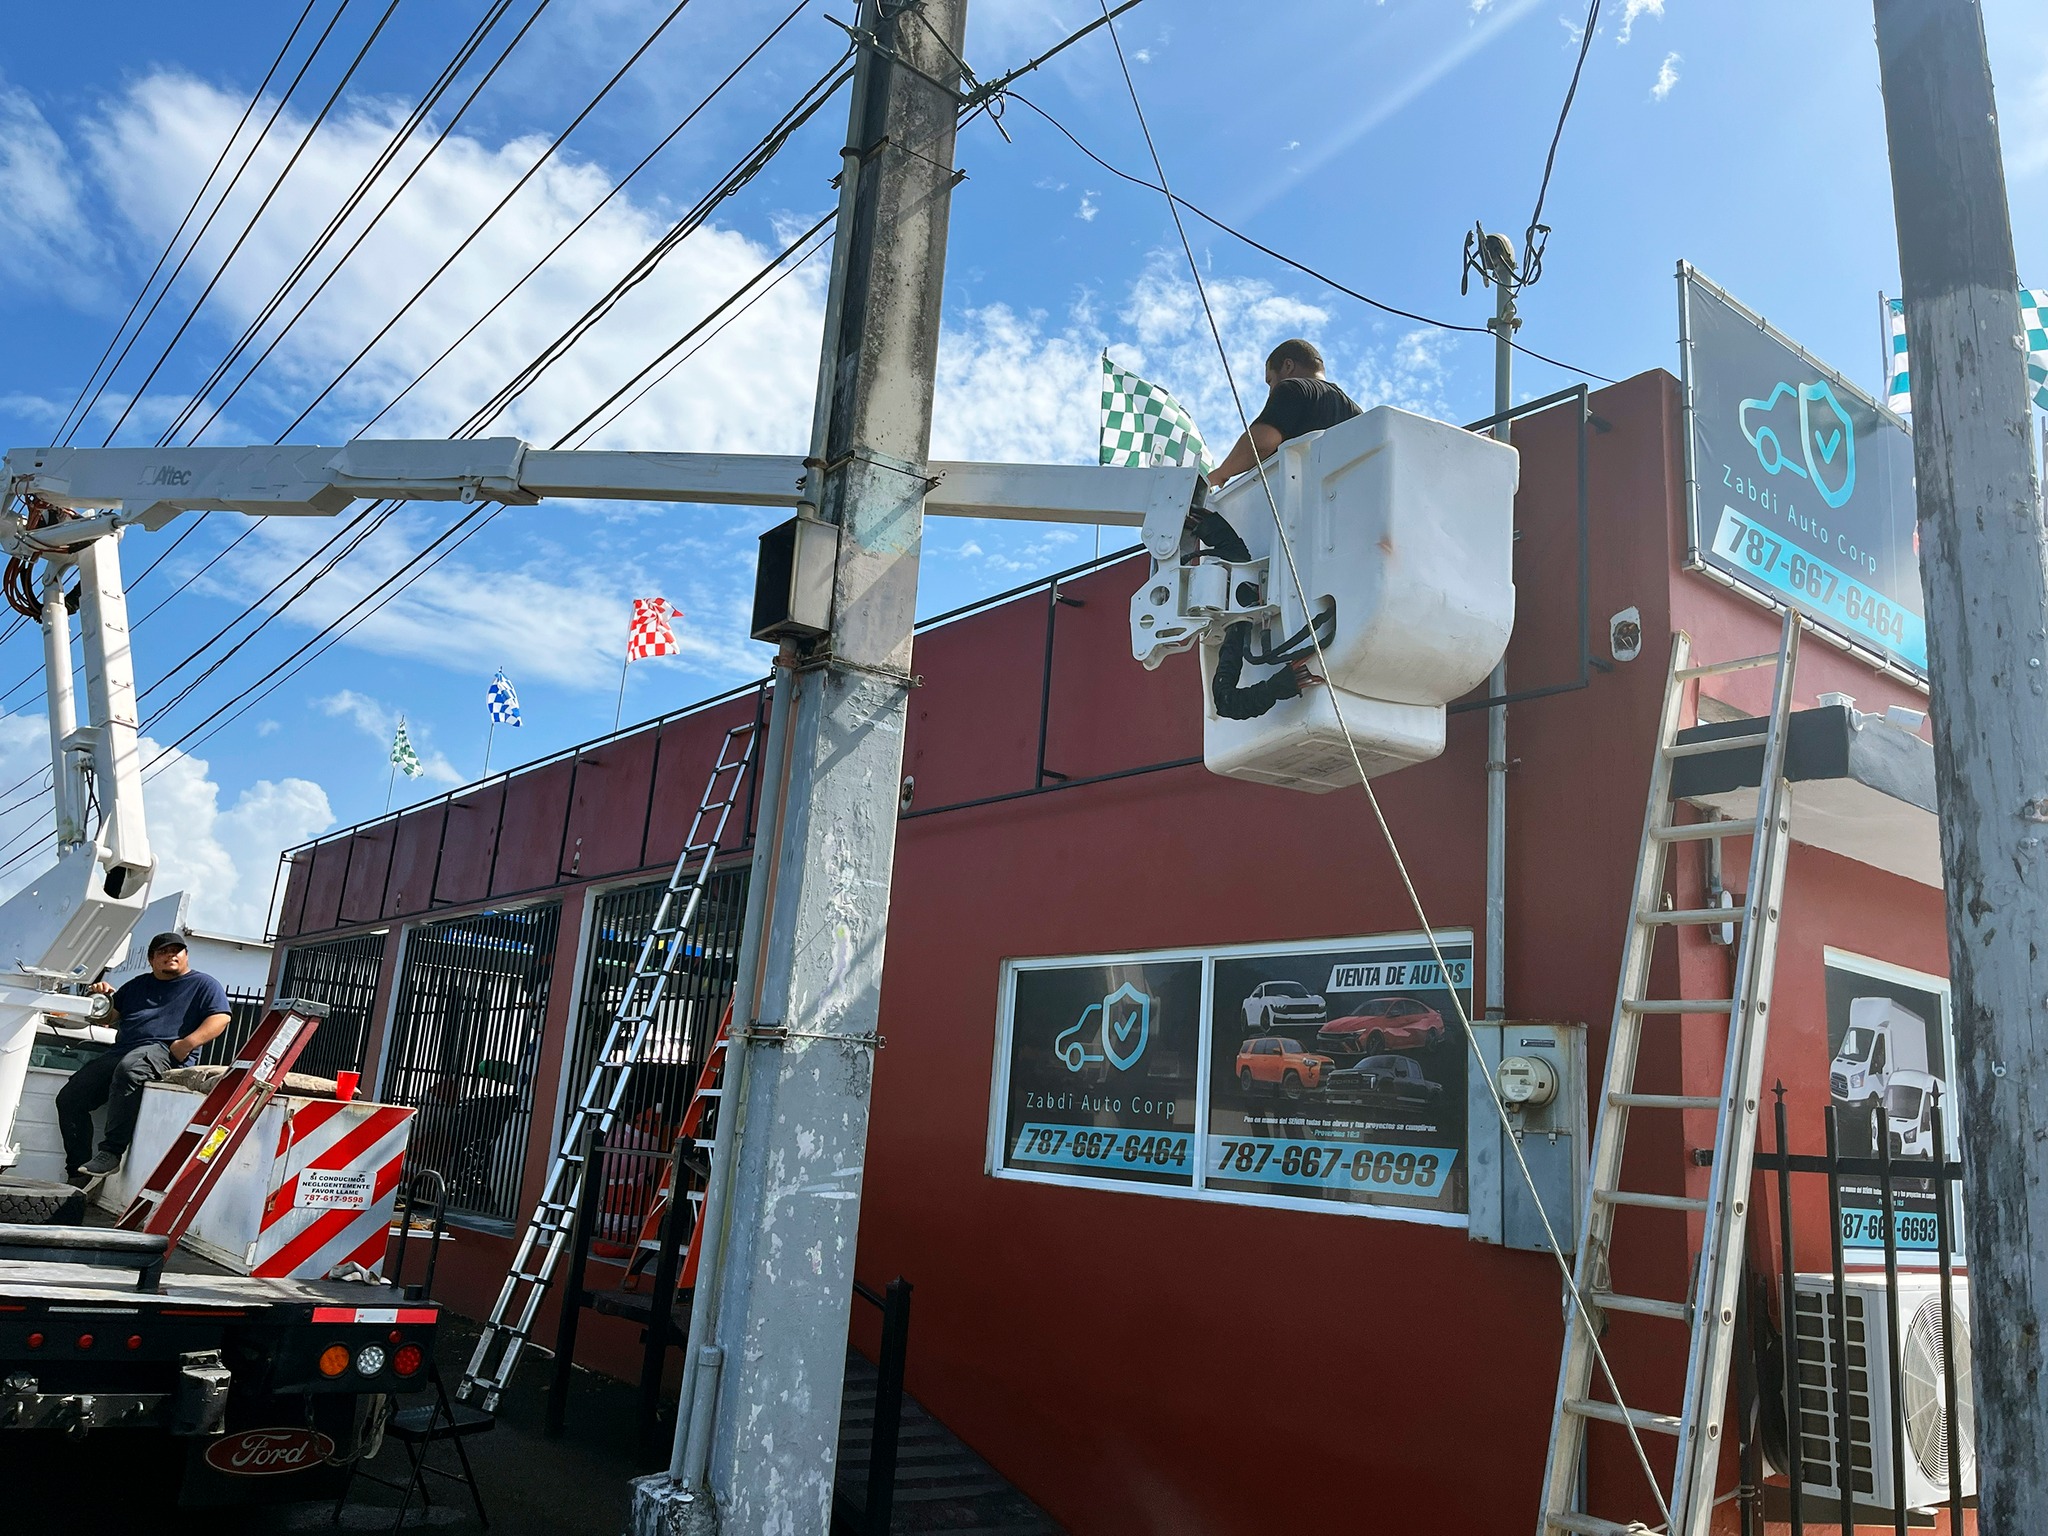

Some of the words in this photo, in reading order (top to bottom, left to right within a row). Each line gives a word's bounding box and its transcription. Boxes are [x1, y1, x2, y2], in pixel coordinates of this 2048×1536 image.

[153, 465, 191, 486] Altec
[1722, 463, 1777, 514] Zabdi
[1787, 504, 1829, 544] Auto
[1837, 534, 1877, 576] Corp
[1728, 515, 1905, 645] 787-667-6464
[1335, 966, 1381, 987] VENTA
[1385, 965, 1406, 985] DE
[1409, 962, 1466, 984] AUTOS
[1026, 1092, 1073, 1110] Zabdi
[1081, 1094, 1122, 1113] Auto
[1131, 1096, 1175, 1120] Corp
[1024, 1128, 1188, 1167] 787-667-6464
[1218, 1141, 1438, 1187] 787-667-6693
[302, 1181, 371, 1190] NEGLIGENTEMENTE
[318, 1175, 366, 1183] CONDUCIMOS
[304, 1194, 364, 1204] 787-617-9598
[231, 1434, 310, 1467] Ford
